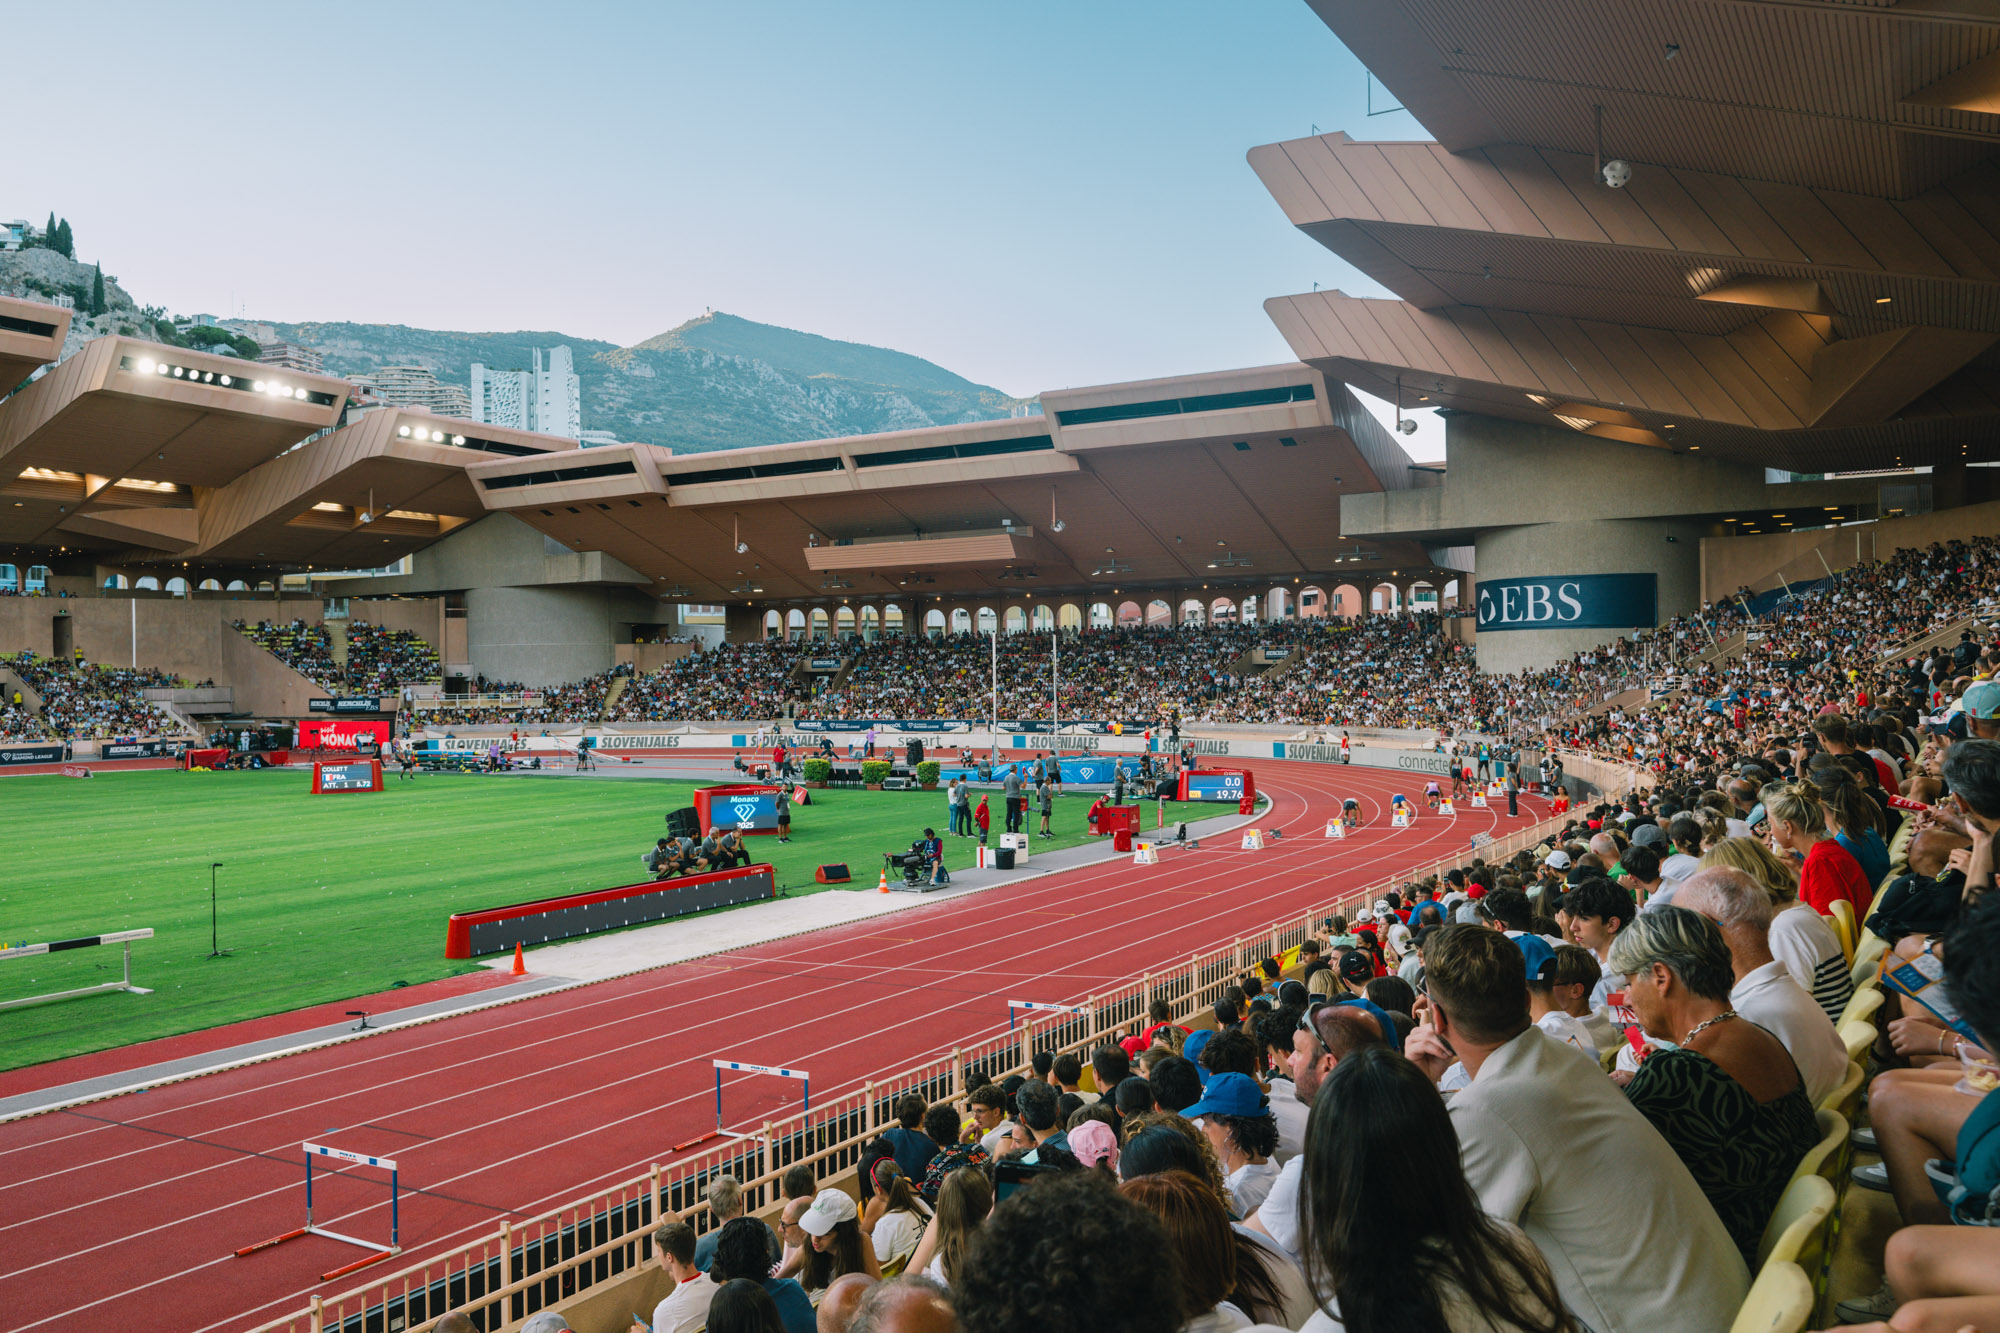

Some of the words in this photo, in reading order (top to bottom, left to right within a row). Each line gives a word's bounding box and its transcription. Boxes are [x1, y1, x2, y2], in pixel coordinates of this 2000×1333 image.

[1500, 582, 1582, 623] EBS
[320, 733, 358, 747] MONAC
[601, 736, 680, 749] SLOVENIJALES
[1398, 756, 1451, 773] connecte
[1225, 777, 1241, 787] 0.0
[1216, 790, 1244, 800] 19.76
[1331, 825, 1336, 833] 3
[1247, 836, 1253, 845] 2
[1140, 851, 1145, 860] 1
